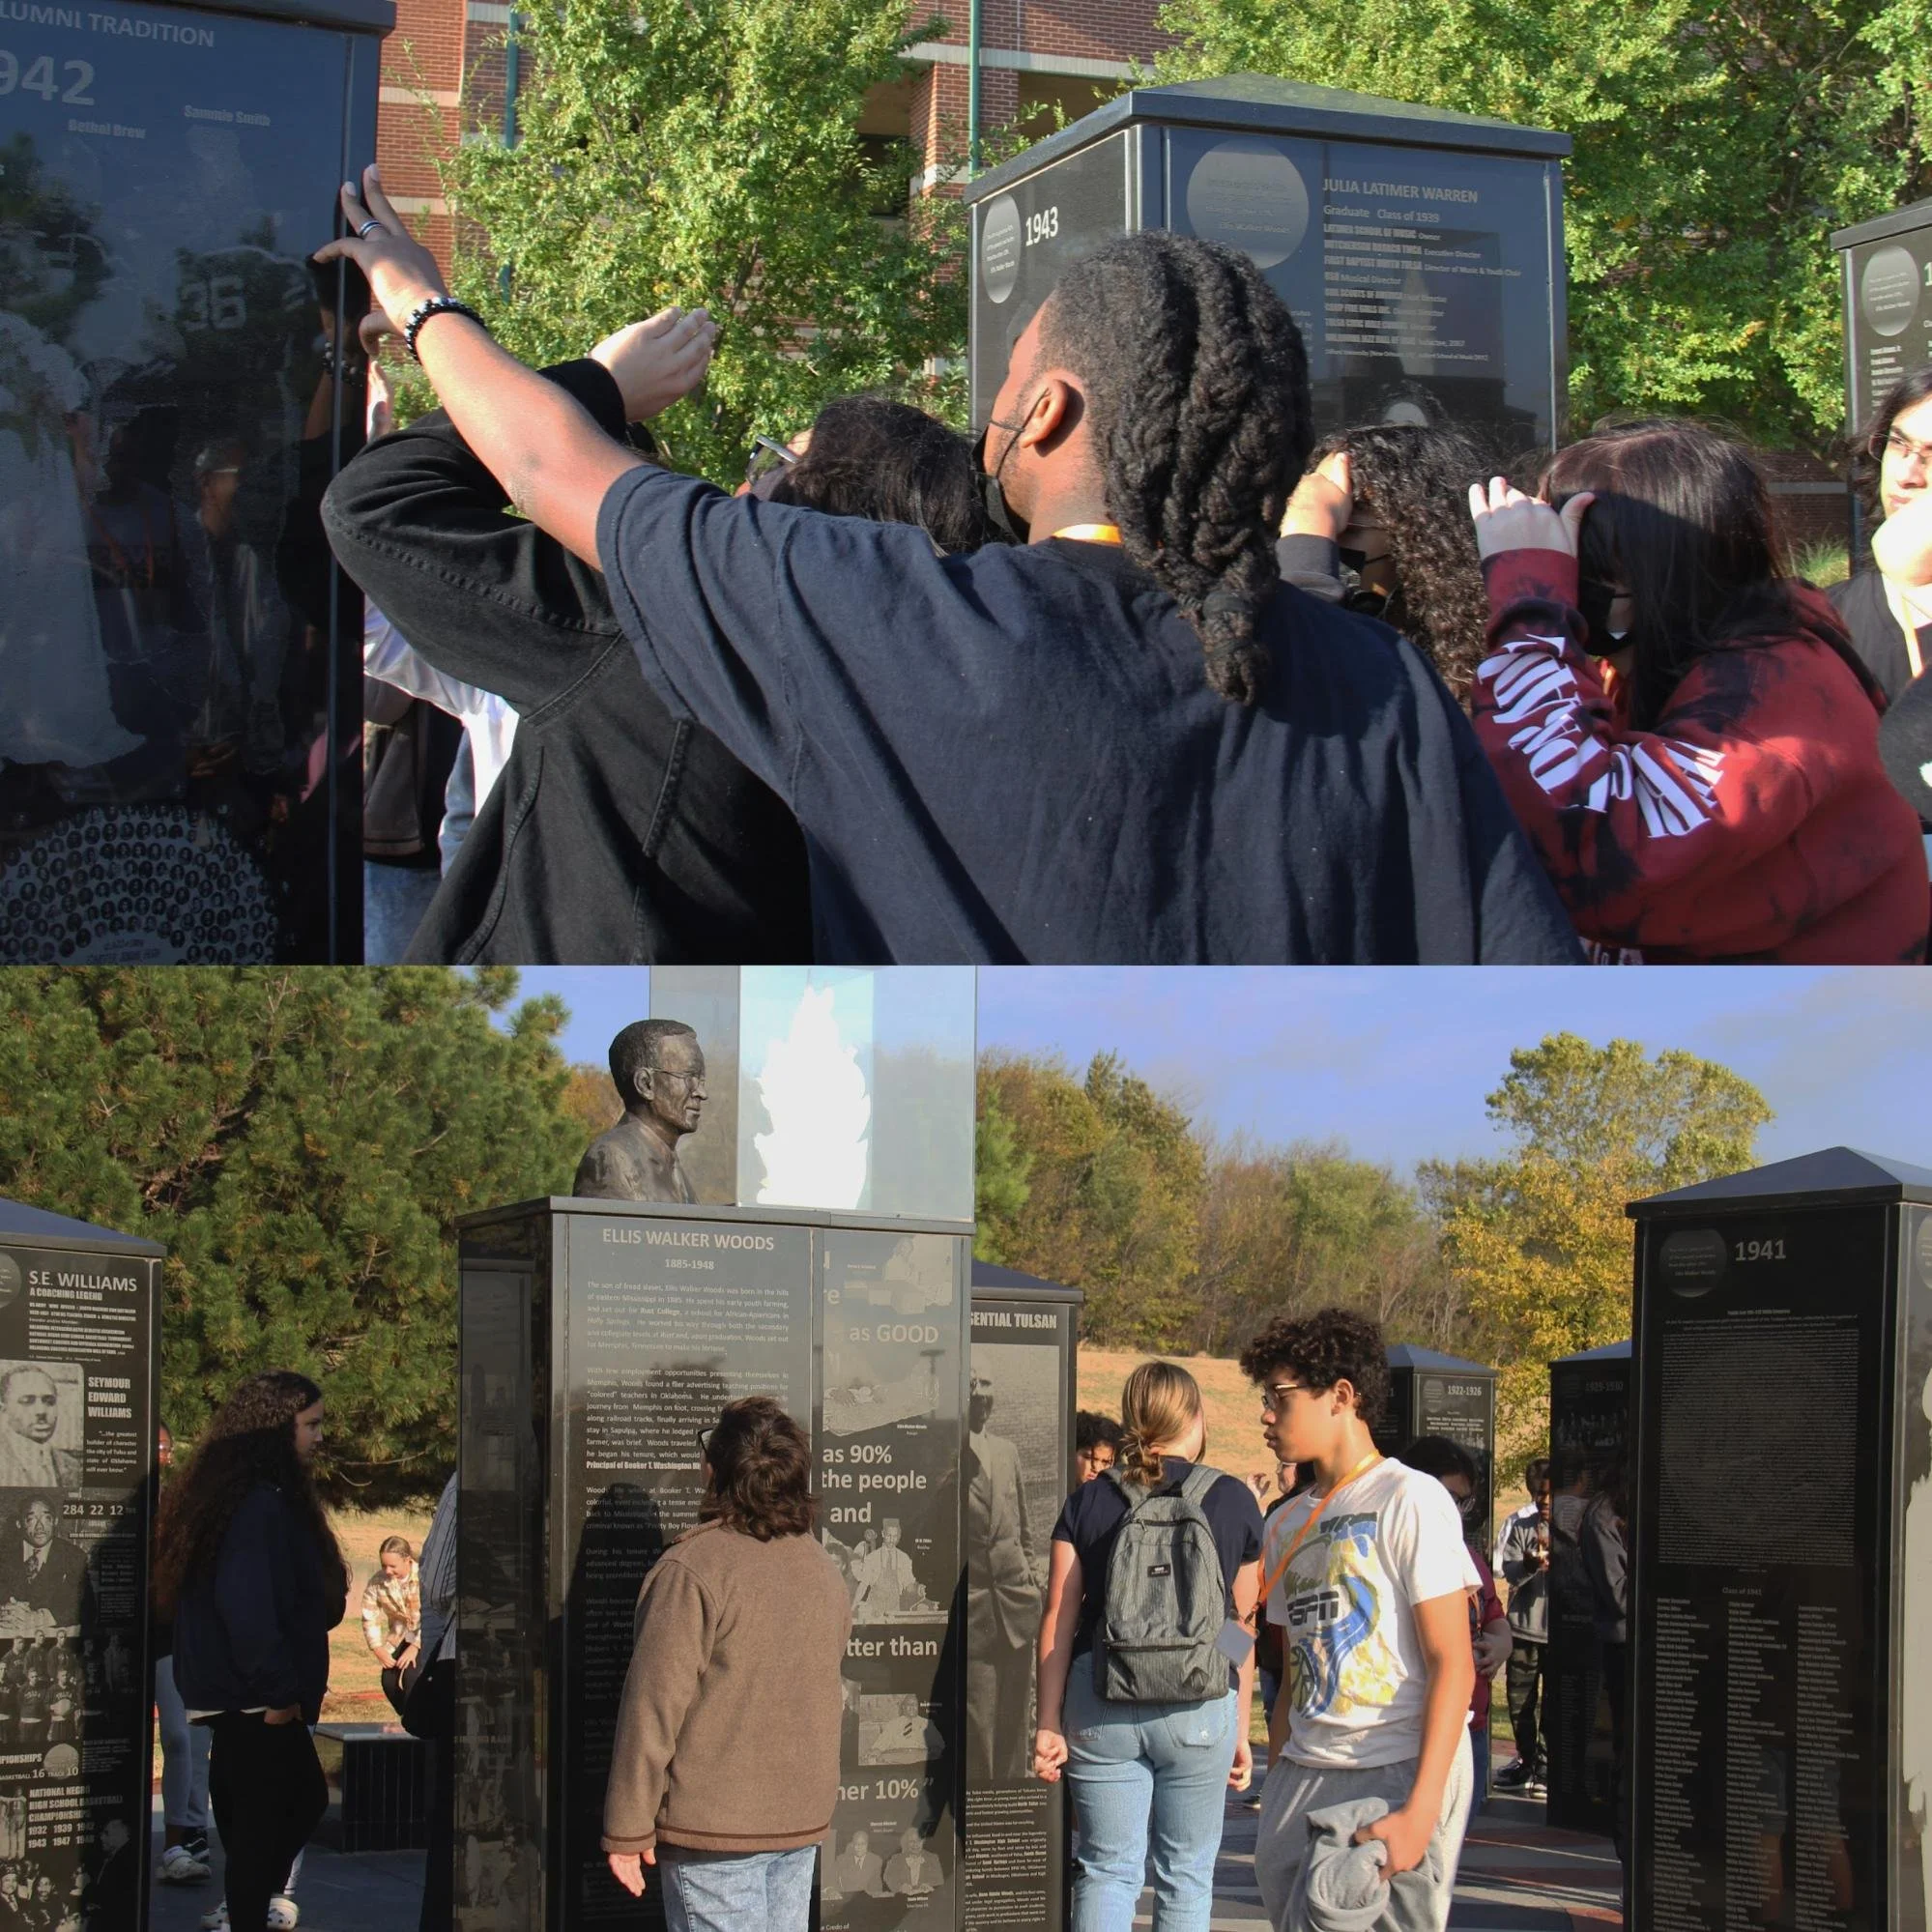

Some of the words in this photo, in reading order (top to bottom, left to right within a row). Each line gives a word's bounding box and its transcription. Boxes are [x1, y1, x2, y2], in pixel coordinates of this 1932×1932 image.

[0, 0, 82, 29] LUMNI
[88, 13, 216, 48] TRADITION
[0, 49, 95, 106] 942
[1322, 179, 1360, 194] JULIA
[1363, 182, 1419, 199] LATIMER
[1422, 187, 1478, 204] WARREN
[1323, 205, 1370, 218] Graduate
[1377, 208, 1401, 220] Class
[1402, 210, 1415, 221] of
[1025, 206, 1058, 246] 1943
[603, 1228, 641, 1244] ELLIS
[646, 1230, 709, 1248] WALKER
[714, 1234, 774, 1251] WOODS
[1735, 1239, 1787, 1261] 1941
[665, 1258, 714, 1270] 1885-1948
[29, 1270, 53, 1285] S.E.
[58, 1272, 137, 1292] WILLIAMS
[30, 1287, 36, 1296] A
[37, 1287, 74, 1299] COACHING
[76, 1290, 102, 1301] LEGEND
[1014, 1313, 1057, 1330] TULSAN
[850, 1327, 870, 1342] as
[877, 1324, 939, 1343] GOOD
[88, 1376, 131, 1389] SEYMOUR
[88, 1392, 127, 1403] EDWARD
[88, 1406, 132, 1419] WILLIAMS
[598, 1451, 618, 1459] began
[822, 1447, 844, 1463] as
[851, 1444, 892, 1464] 90%
[586, 1460, 616, 1470] Principal
[617, 1460, 624, 1469] of
[653, 1461, 692, 1471] Washington
[822, 1468, 852, 1488] the
[859, 1469, 927, 1493] people
[63, 1505, 85, 1515] 284
[90, 1505, 104, 1515] 22
[109, 1505, 124, 1515] 12
[830, 1501, 872, 1523] and
[847, 1638, 884, 1657] tter
[889, 1635, 937, 1657] than
[0, 1753, 42, 1765] PIONSHIPS
[29, 1787, 65, 1799] NATIONAL
[66, 1785, 90, 1796] NEGRO
[29, 1800, 48, 1810] HIGH
[49, 1798, 78, 1809] SCHOOL
[79, 1795, 124, 1807] BASKETBALL
